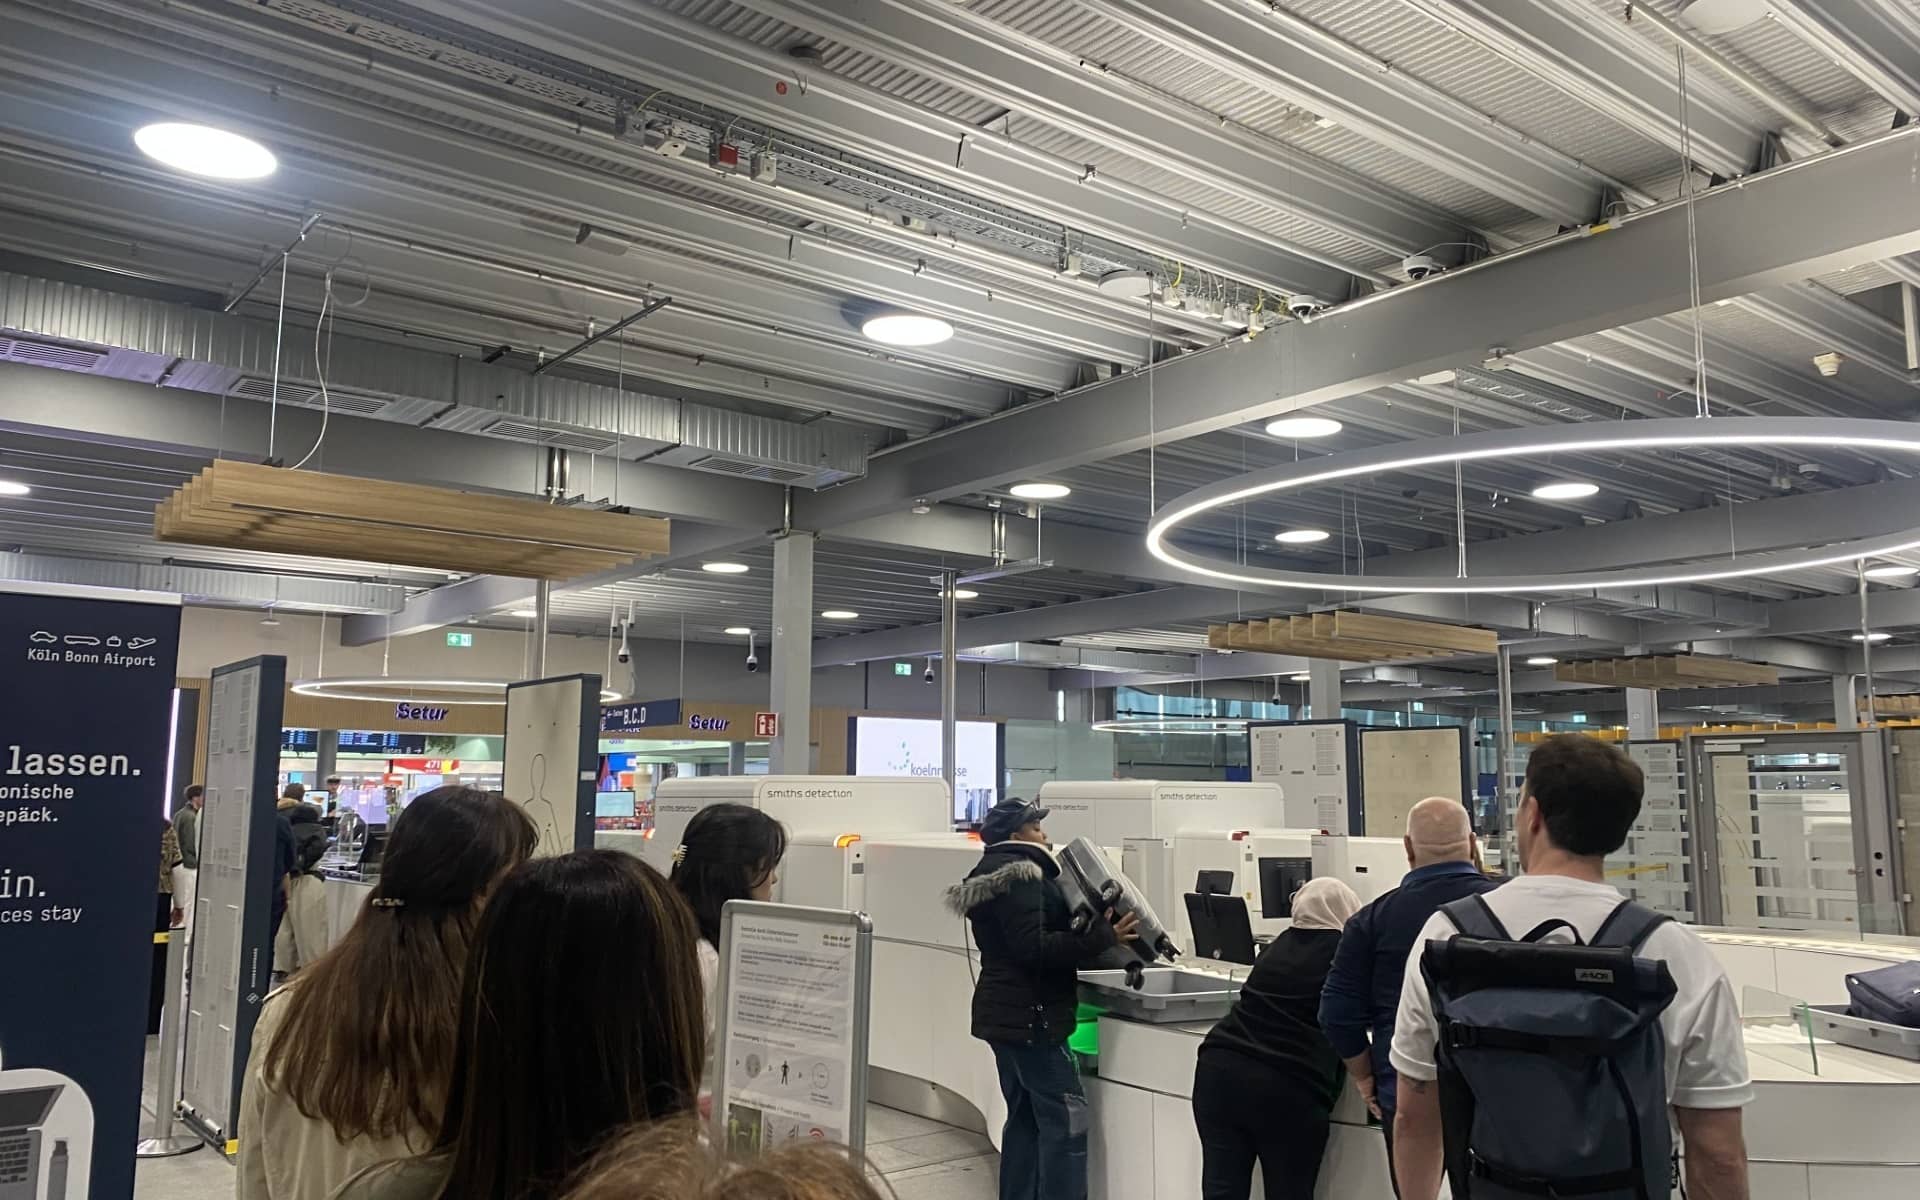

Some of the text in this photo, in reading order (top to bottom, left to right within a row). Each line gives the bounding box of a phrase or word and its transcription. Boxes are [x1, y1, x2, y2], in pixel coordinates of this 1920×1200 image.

[27, 648, 156, 668] Köln Bonn Airport
[396, 702, 449, 720] Setur
[689, 714, 730, 731] Setur
[6, 745, 141, 776] lassen.
[767, 788, 853, 799] smiths detection
[41, 905, 82, 923] stay
